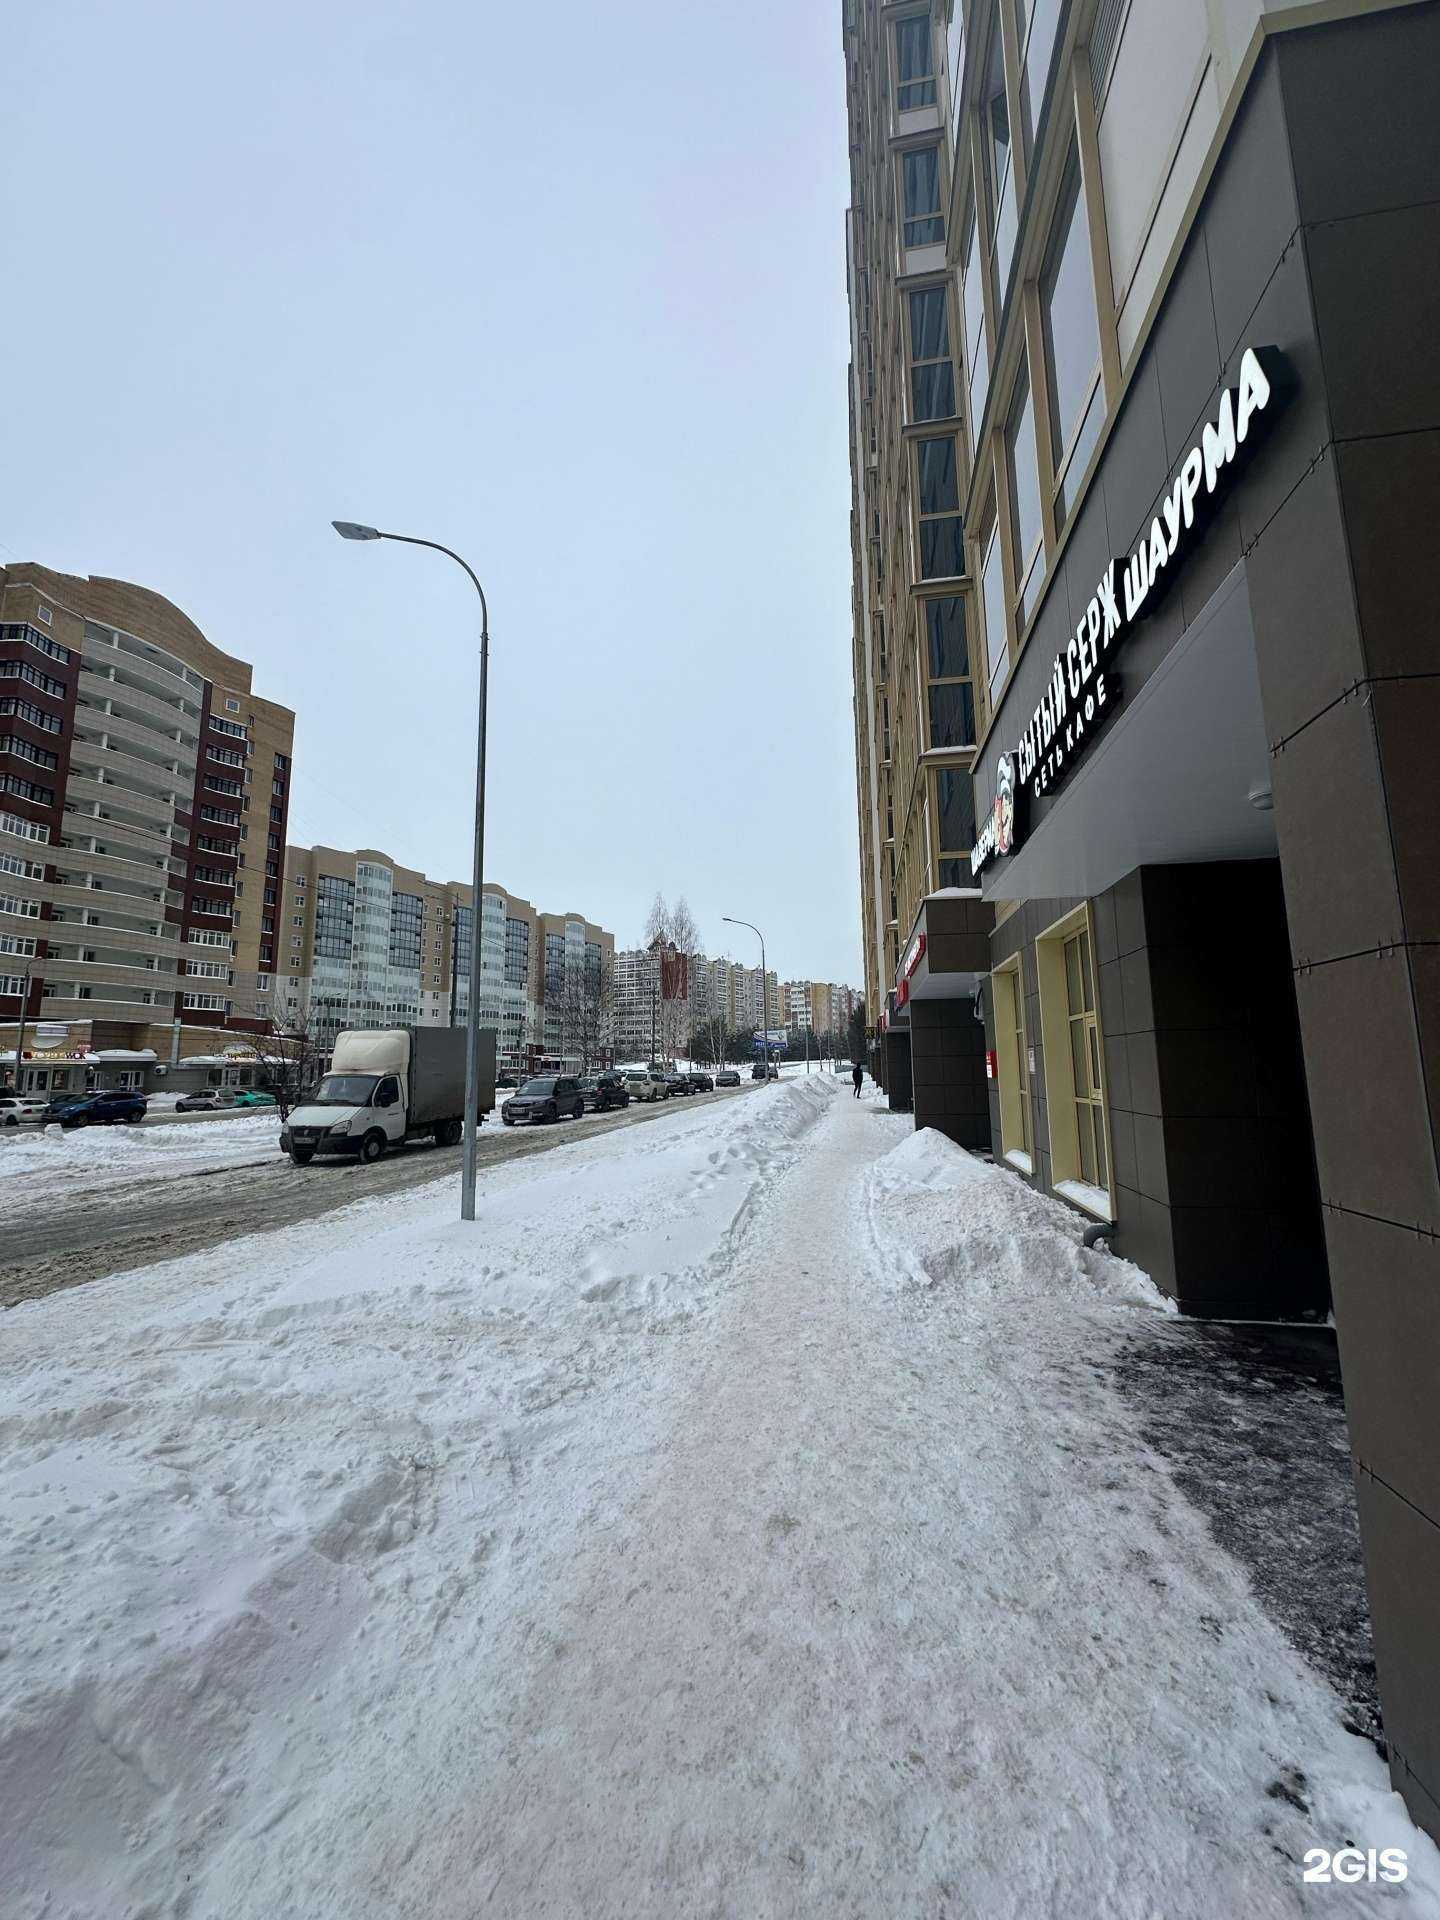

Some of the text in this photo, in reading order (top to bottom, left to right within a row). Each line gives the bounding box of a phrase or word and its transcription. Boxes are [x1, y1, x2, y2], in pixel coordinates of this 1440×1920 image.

[1124, 348, 1270, 622] ШАУРМА
[1018, 559, 1121, 785] СЫТЫЙ СЕРЖ
[1034, 673, 1107, 798] СЕТЬ КАФЕ
